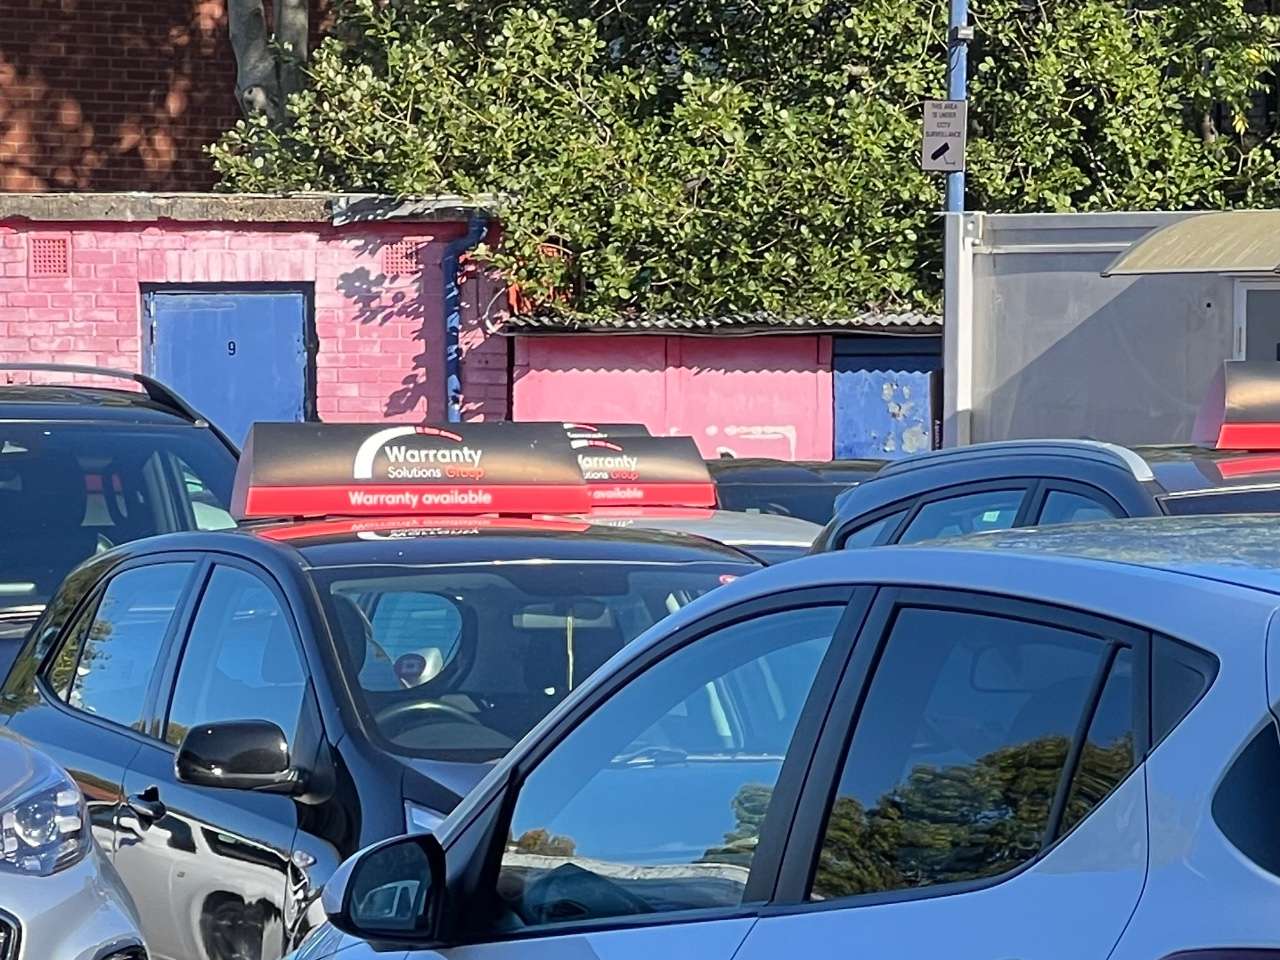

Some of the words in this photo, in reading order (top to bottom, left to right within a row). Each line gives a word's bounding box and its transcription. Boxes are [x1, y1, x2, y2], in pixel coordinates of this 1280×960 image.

[228, 341, 236, 356] 9
[384, 446, 482, 468] Warranty
[387, 466, 441, 479] Solutions
[445, 466, 485, 480] Group
[610, 470, 639, 480] Group
[349, 491, 419, 508] Warranty
[422, 490, 492, 505] available
[593, 487, 644, 499] available
